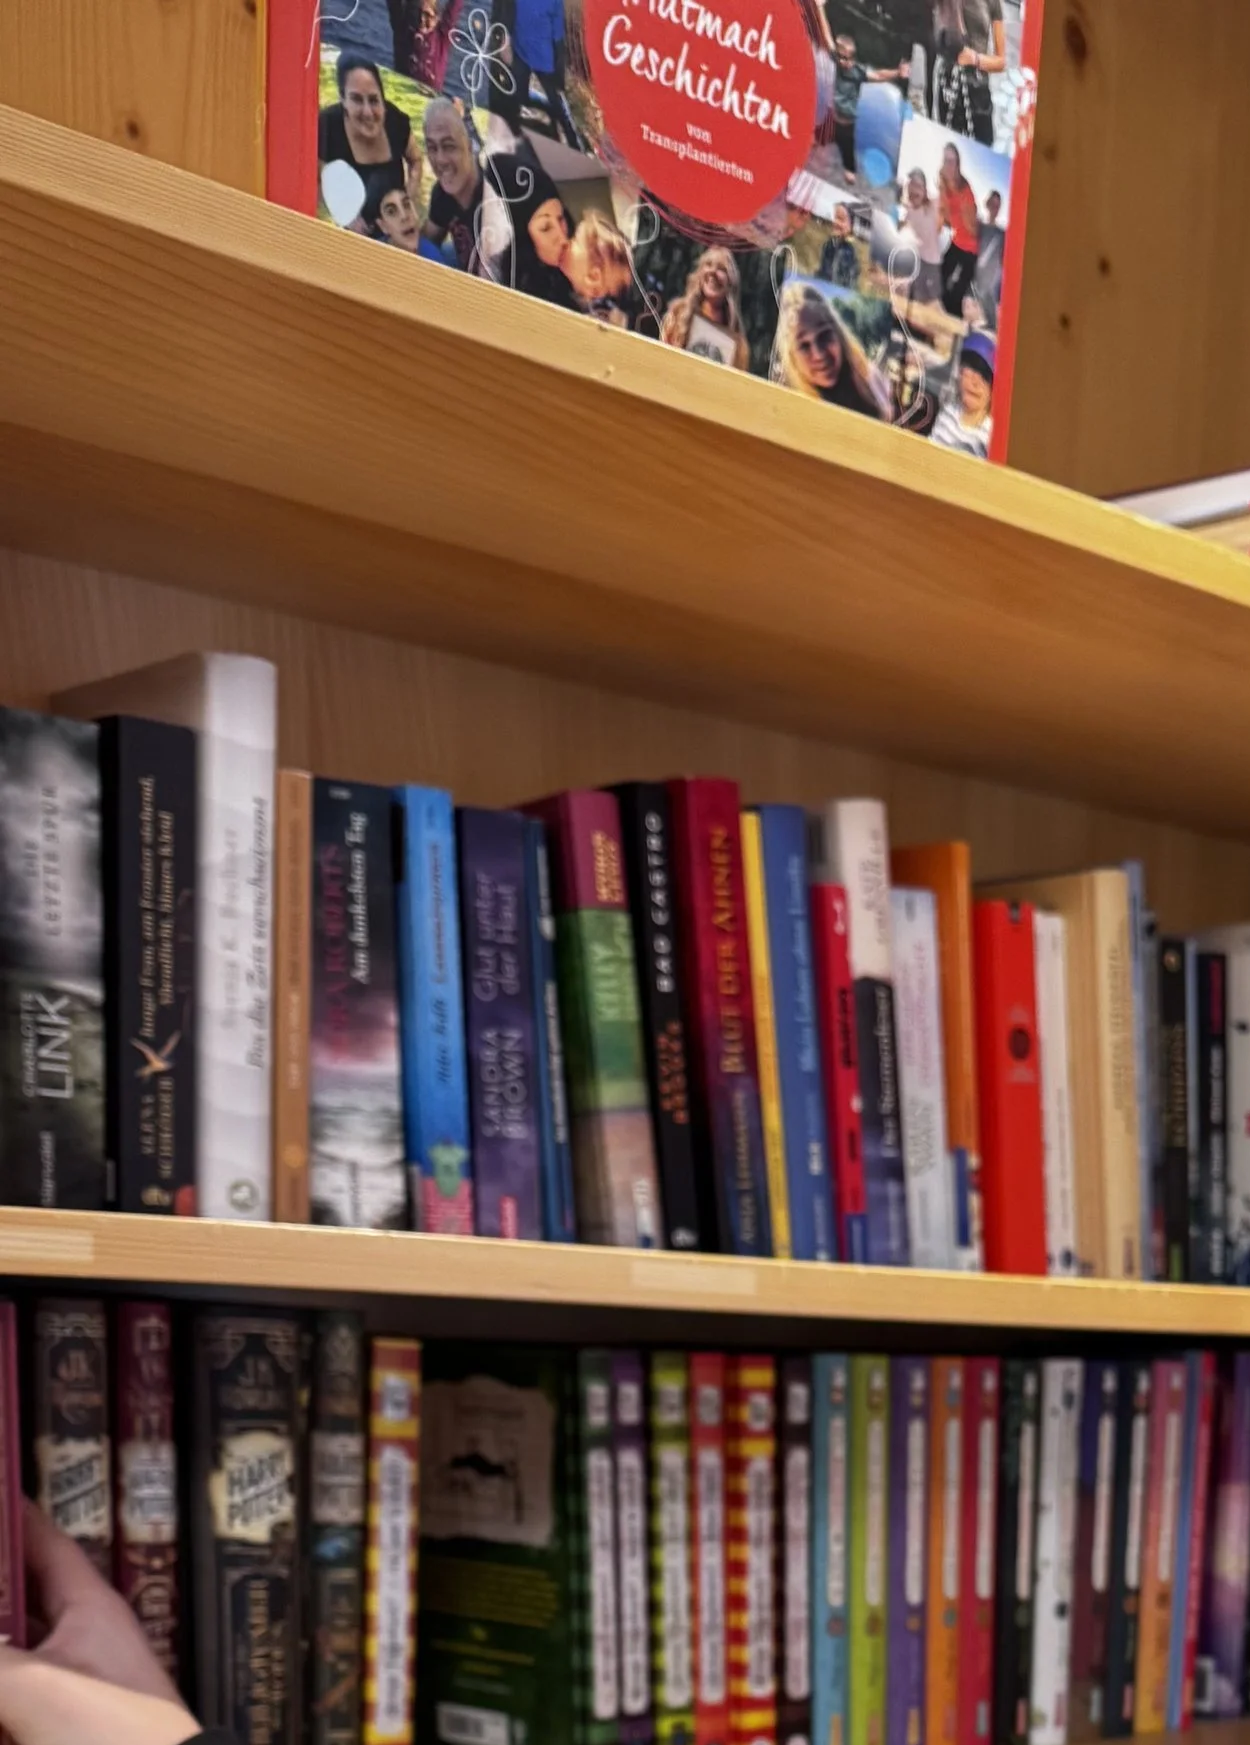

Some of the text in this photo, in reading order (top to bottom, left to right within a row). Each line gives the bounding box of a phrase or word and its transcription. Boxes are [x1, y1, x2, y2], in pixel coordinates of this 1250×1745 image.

[602, 13, 792, 140] Geschichten
[640, 123, 755, 185] Transplantierten
[686, 121, 713, 145] von
[39, 784, 62, 937] LETZTE SPUR
[319, 842, 347, 973] ROBERTS
[645, 810, 674, 995] BAD CASTRO
[471, 871, 498, 1003] Glut unter
[494, 884, 520, 995] der Haut
[709, 825, 745, 1075] BLUT DER AHNEN
[21, 990, 37, 1099] CHARLOTTE
[38, 989, 75, 1101] LINK
[478, 1029, 503, 1140] SANDRA
[499, 1029, 528, 1141] BROWN
[227, 1451, 288, 1496] HARRY
